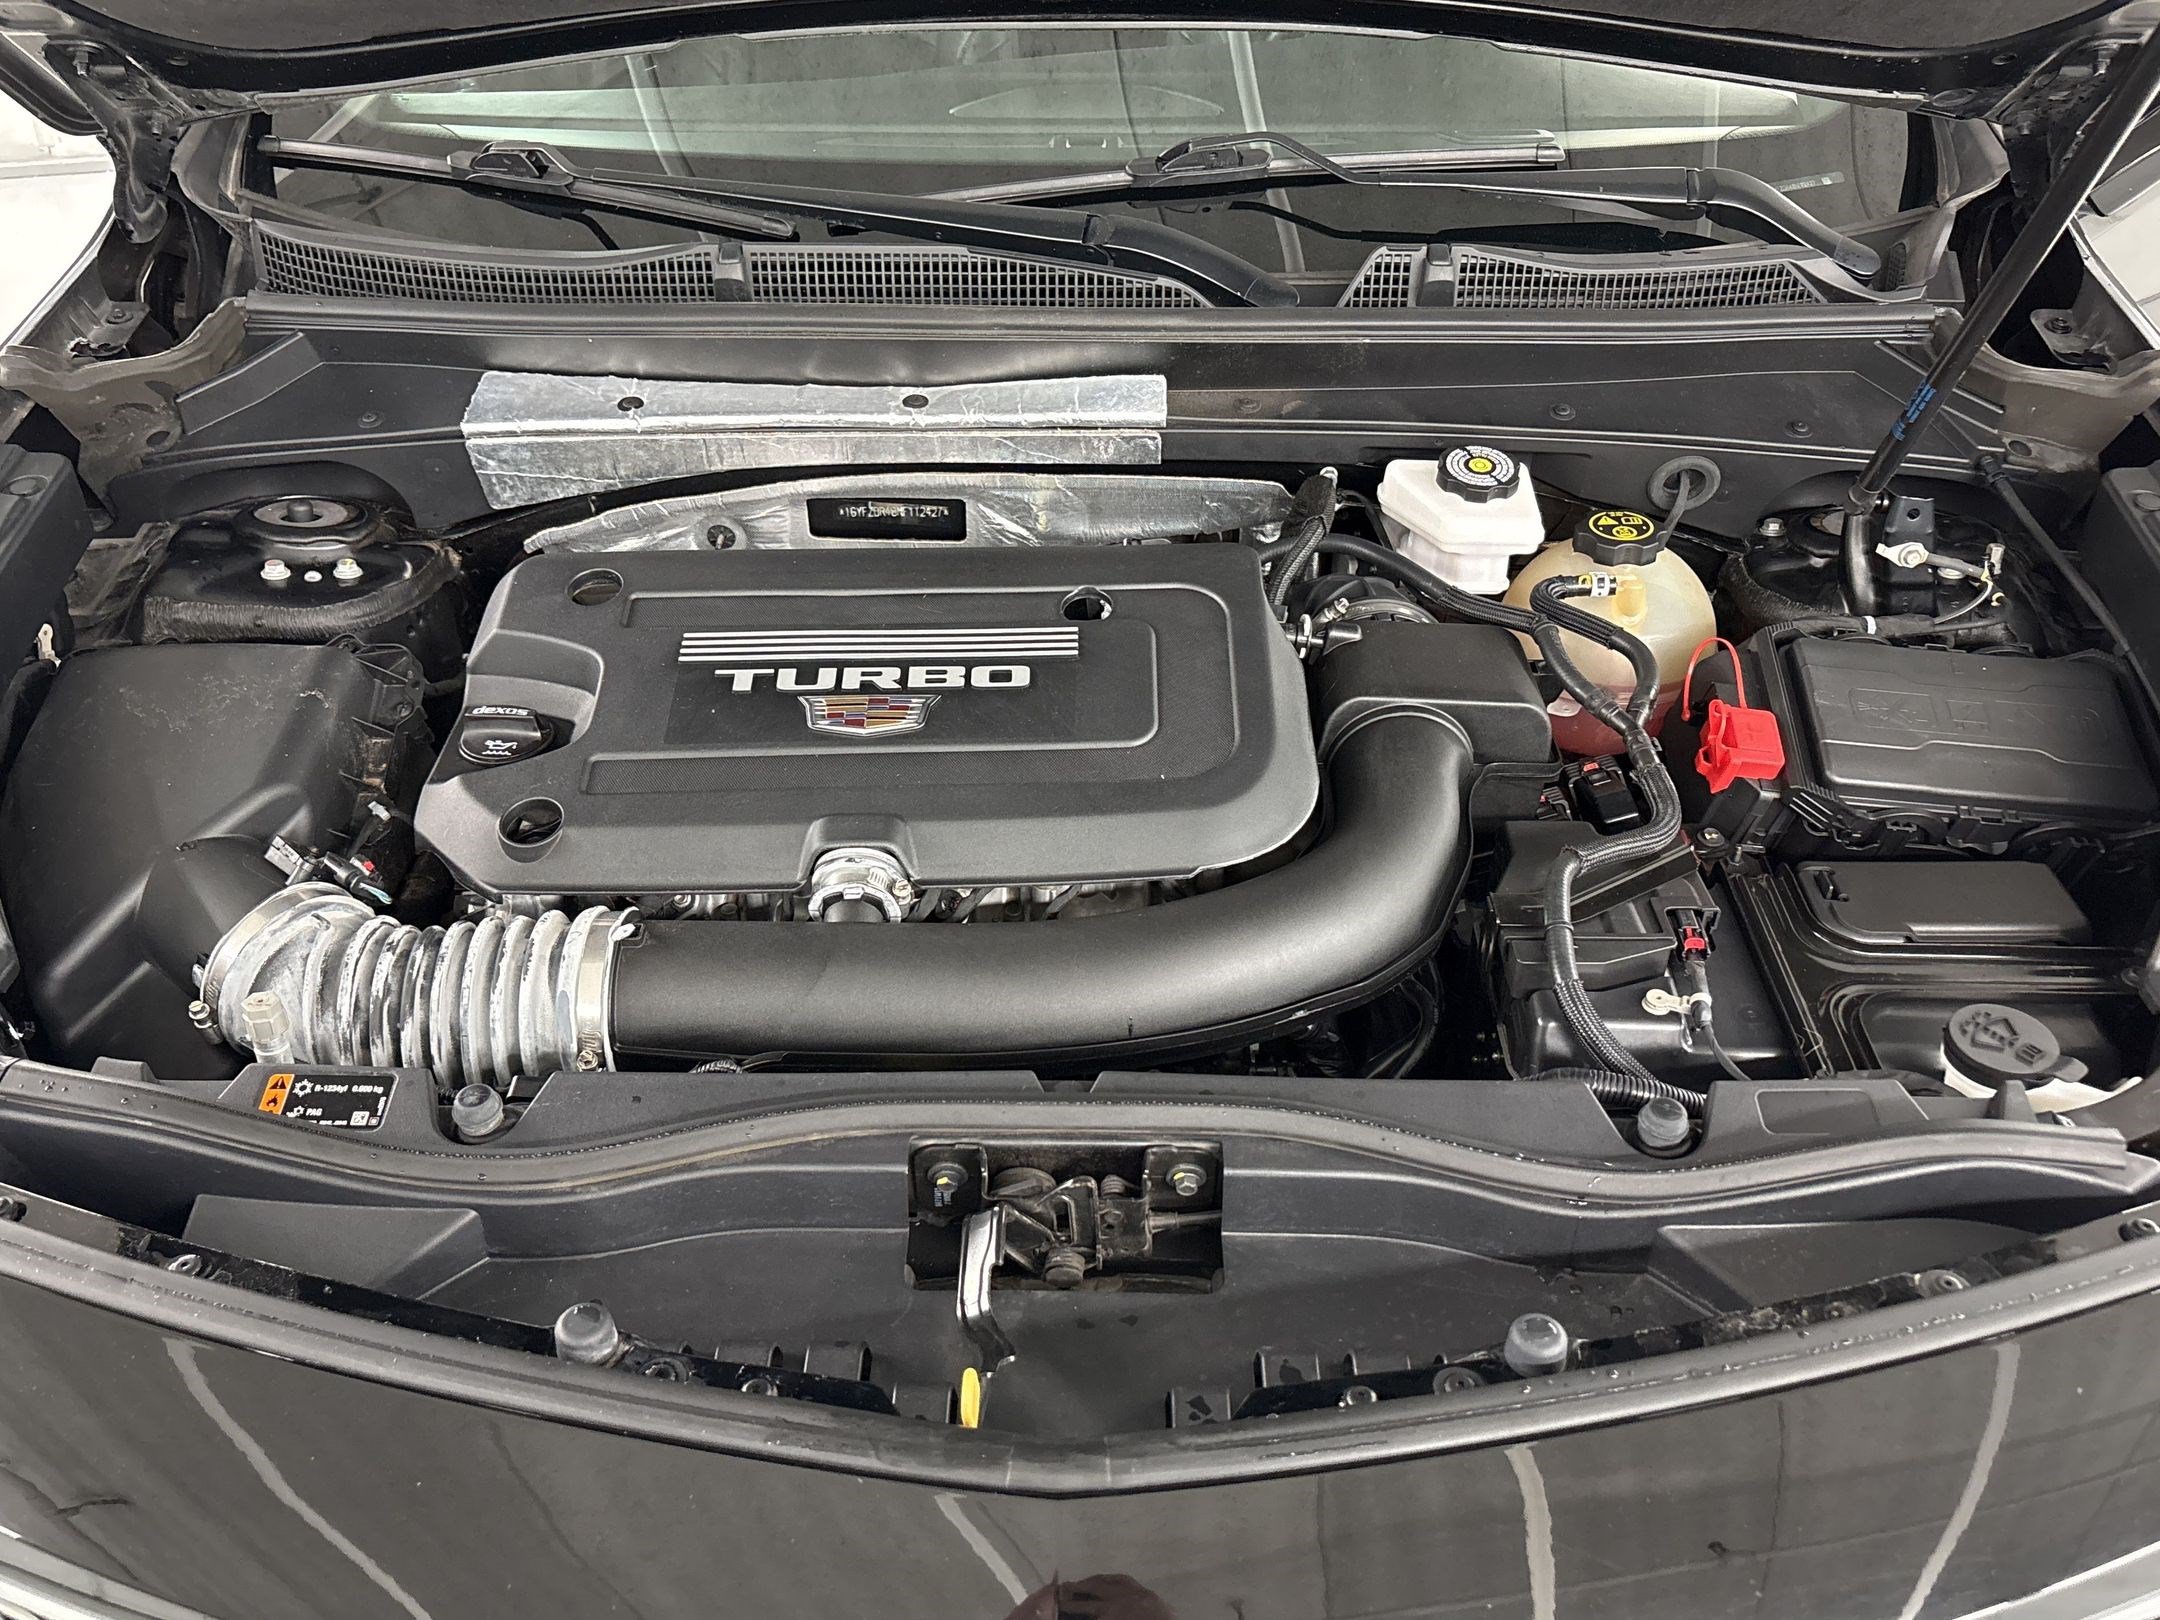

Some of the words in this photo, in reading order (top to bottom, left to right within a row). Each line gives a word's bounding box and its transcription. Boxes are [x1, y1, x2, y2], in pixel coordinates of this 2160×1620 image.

[714, 665, 1031, 694] TURBO
[472, 705, 529, 716] dexos
[314, 1084, 348, 1093] R-1234yf
[373, 1085, 384, 1094] kg
[305, 1108, 323, 1116] PAG
